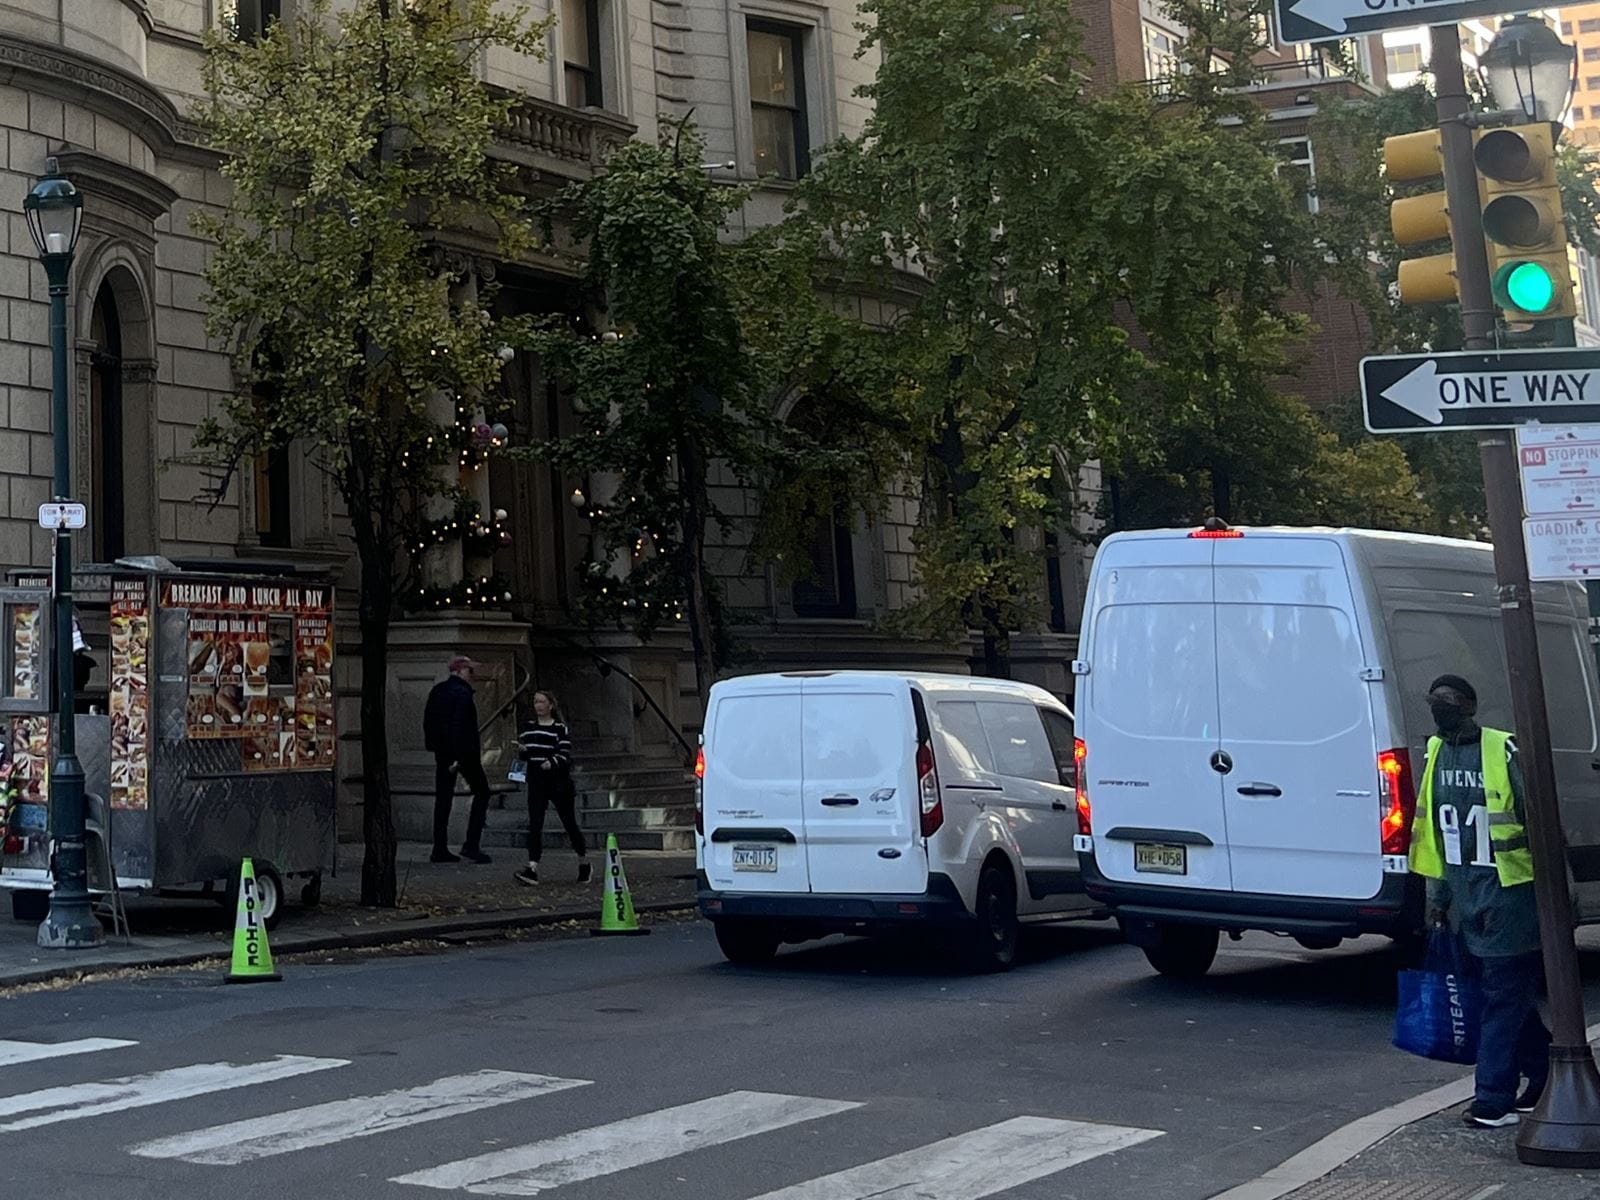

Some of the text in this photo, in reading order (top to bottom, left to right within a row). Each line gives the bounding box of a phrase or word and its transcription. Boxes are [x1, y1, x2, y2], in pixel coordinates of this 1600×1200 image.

[1439, 372, 1591, 405] ONE WAY
[1524, 448, 1600, 463] NO STOPPIN
[171, 584, 323, 608] BREAKFAST AND LUNCH ALL DAY
